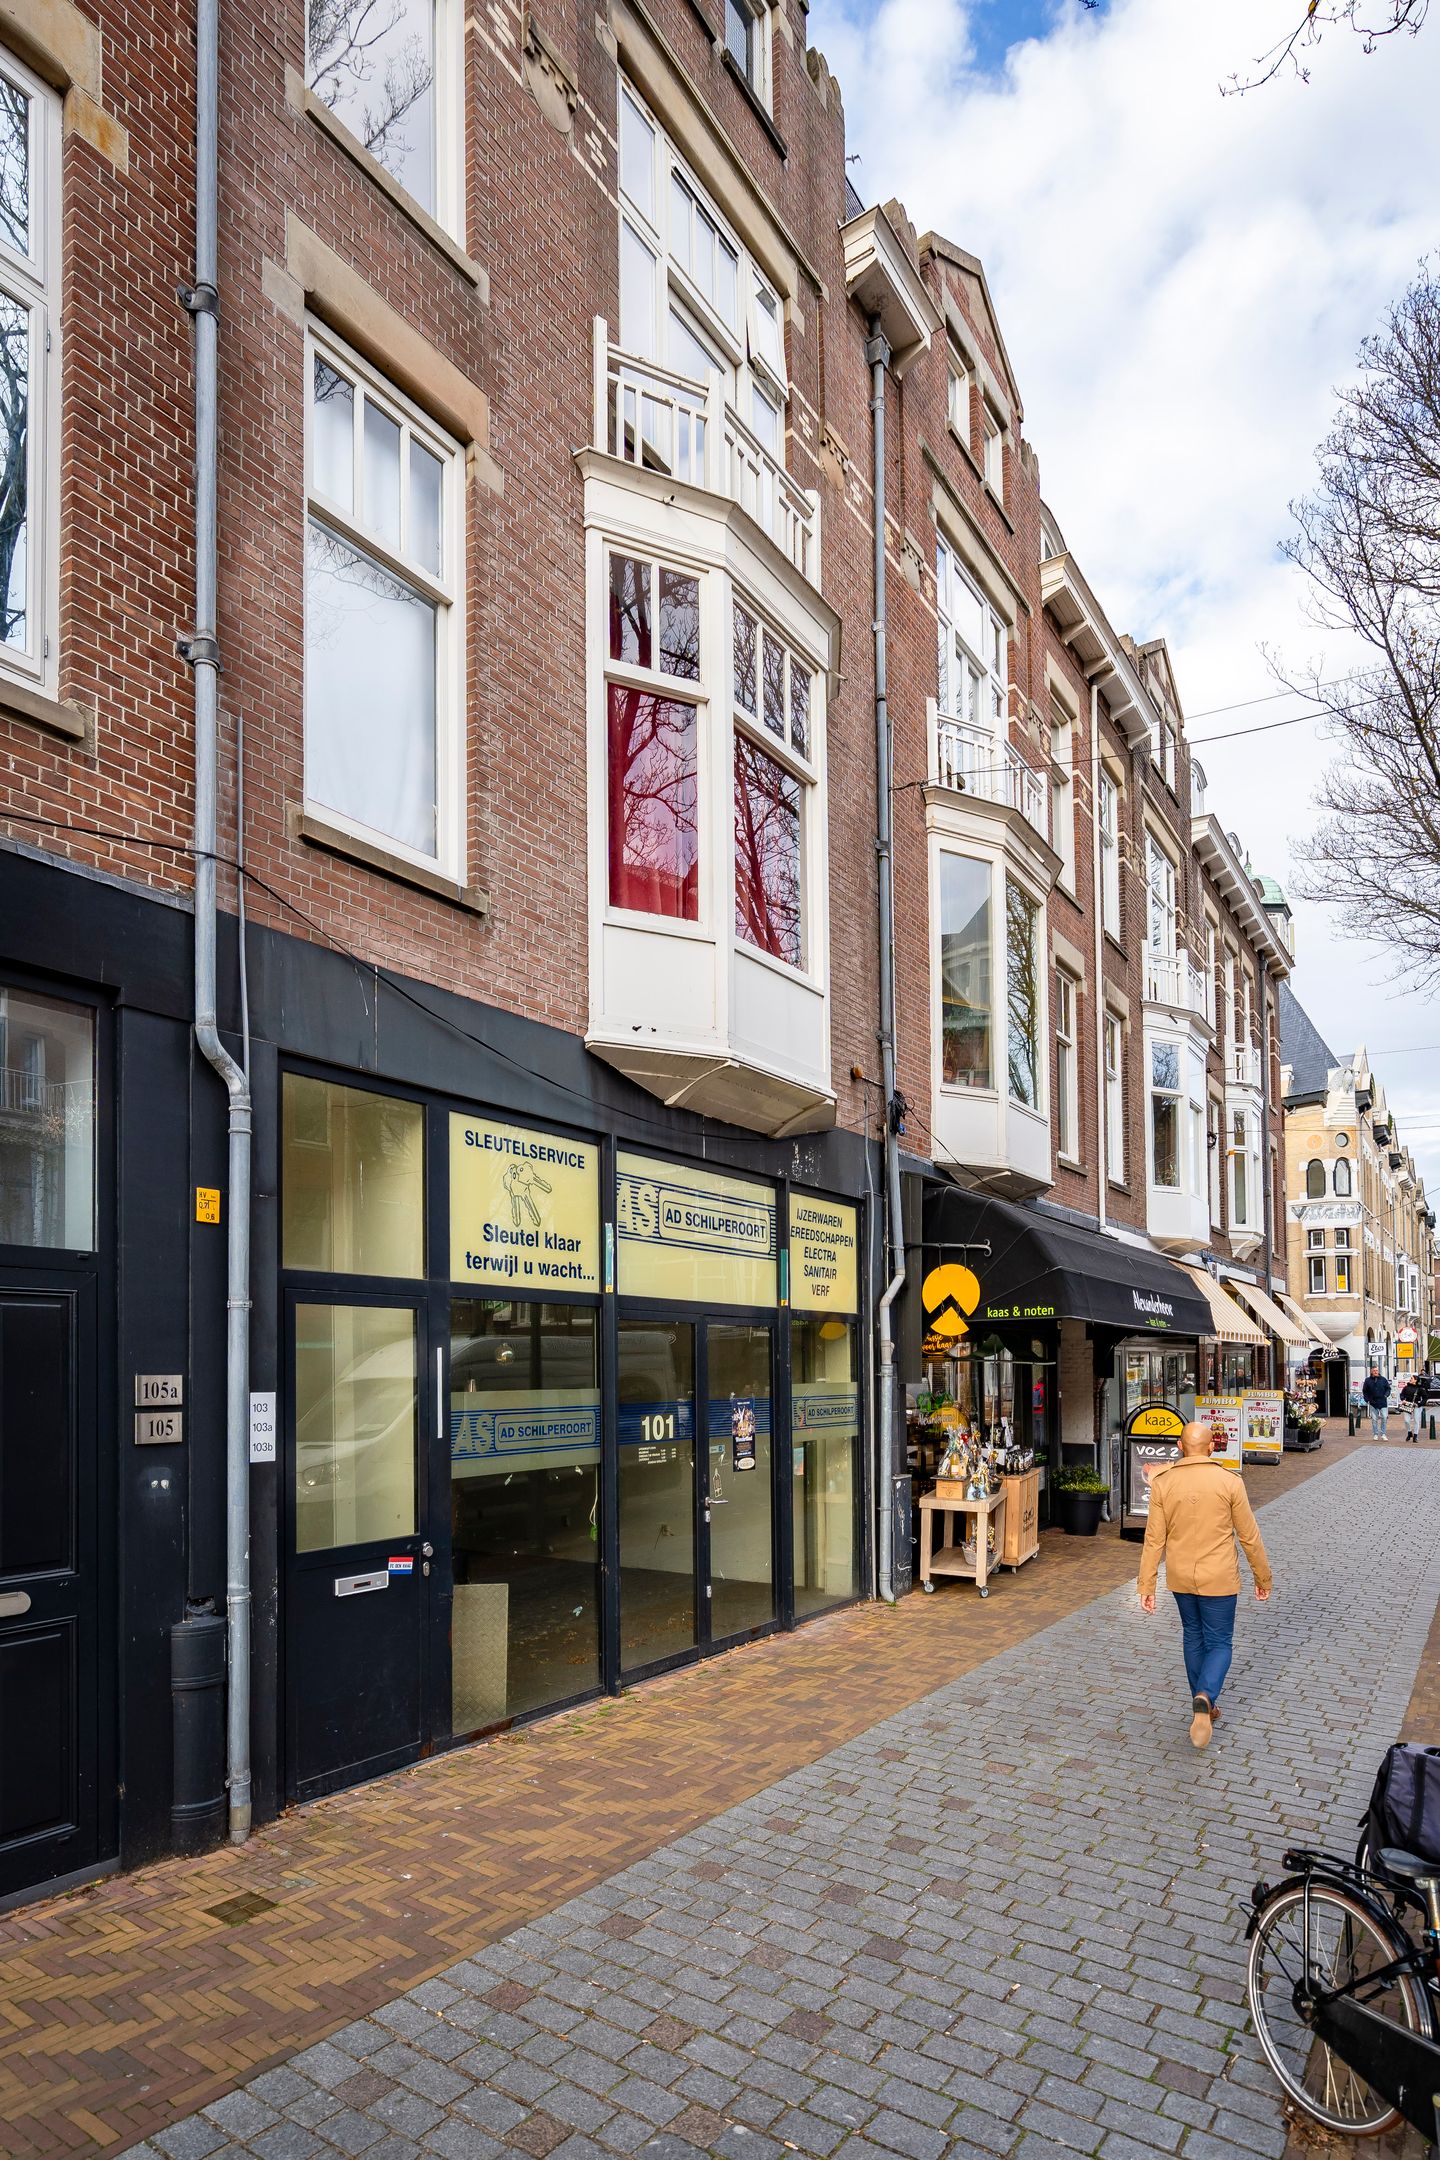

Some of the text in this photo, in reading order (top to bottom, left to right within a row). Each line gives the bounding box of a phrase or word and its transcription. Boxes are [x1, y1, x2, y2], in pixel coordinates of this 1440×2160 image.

[464, 1130, 585, 1169] SLEUTELSERVICE
[665, 1208, 766, 1239] AD SCHILPEROORT
[796, 1208, 843, 1228] IJZERWAREN
[482, 1223, 581, 1252] Sleutel klaar
[803, 1246, 837, 1262] ELECTRA
[465, 1251, 595, 1281] terwijl u wacht...
[803, 1264, 837, 1280] SANITAIR
[811, 1284, 830, 1297] VERF
[987, 1305, 1055, 1318] kaas & noten
[143, 1382, 178, 1399] 105a
[252, 1403, 268, 1413] 103
[1201, 1397, 1237, 1405] JUMBO
[808, 1408, 816, 1417] AD
[1145, 1413, 1172, 1427] kaas
[149, 1419, 174, 1437] 105
[252, 1422, 273, 1432] 103a
[500, 1422, 592, 1439] AD SCHILPEROORT
[641, 1415, 674, 1441] 101
[252, 1442, 273, 1452] 103b
[1136, 1445, 1167, 1456] VOC
